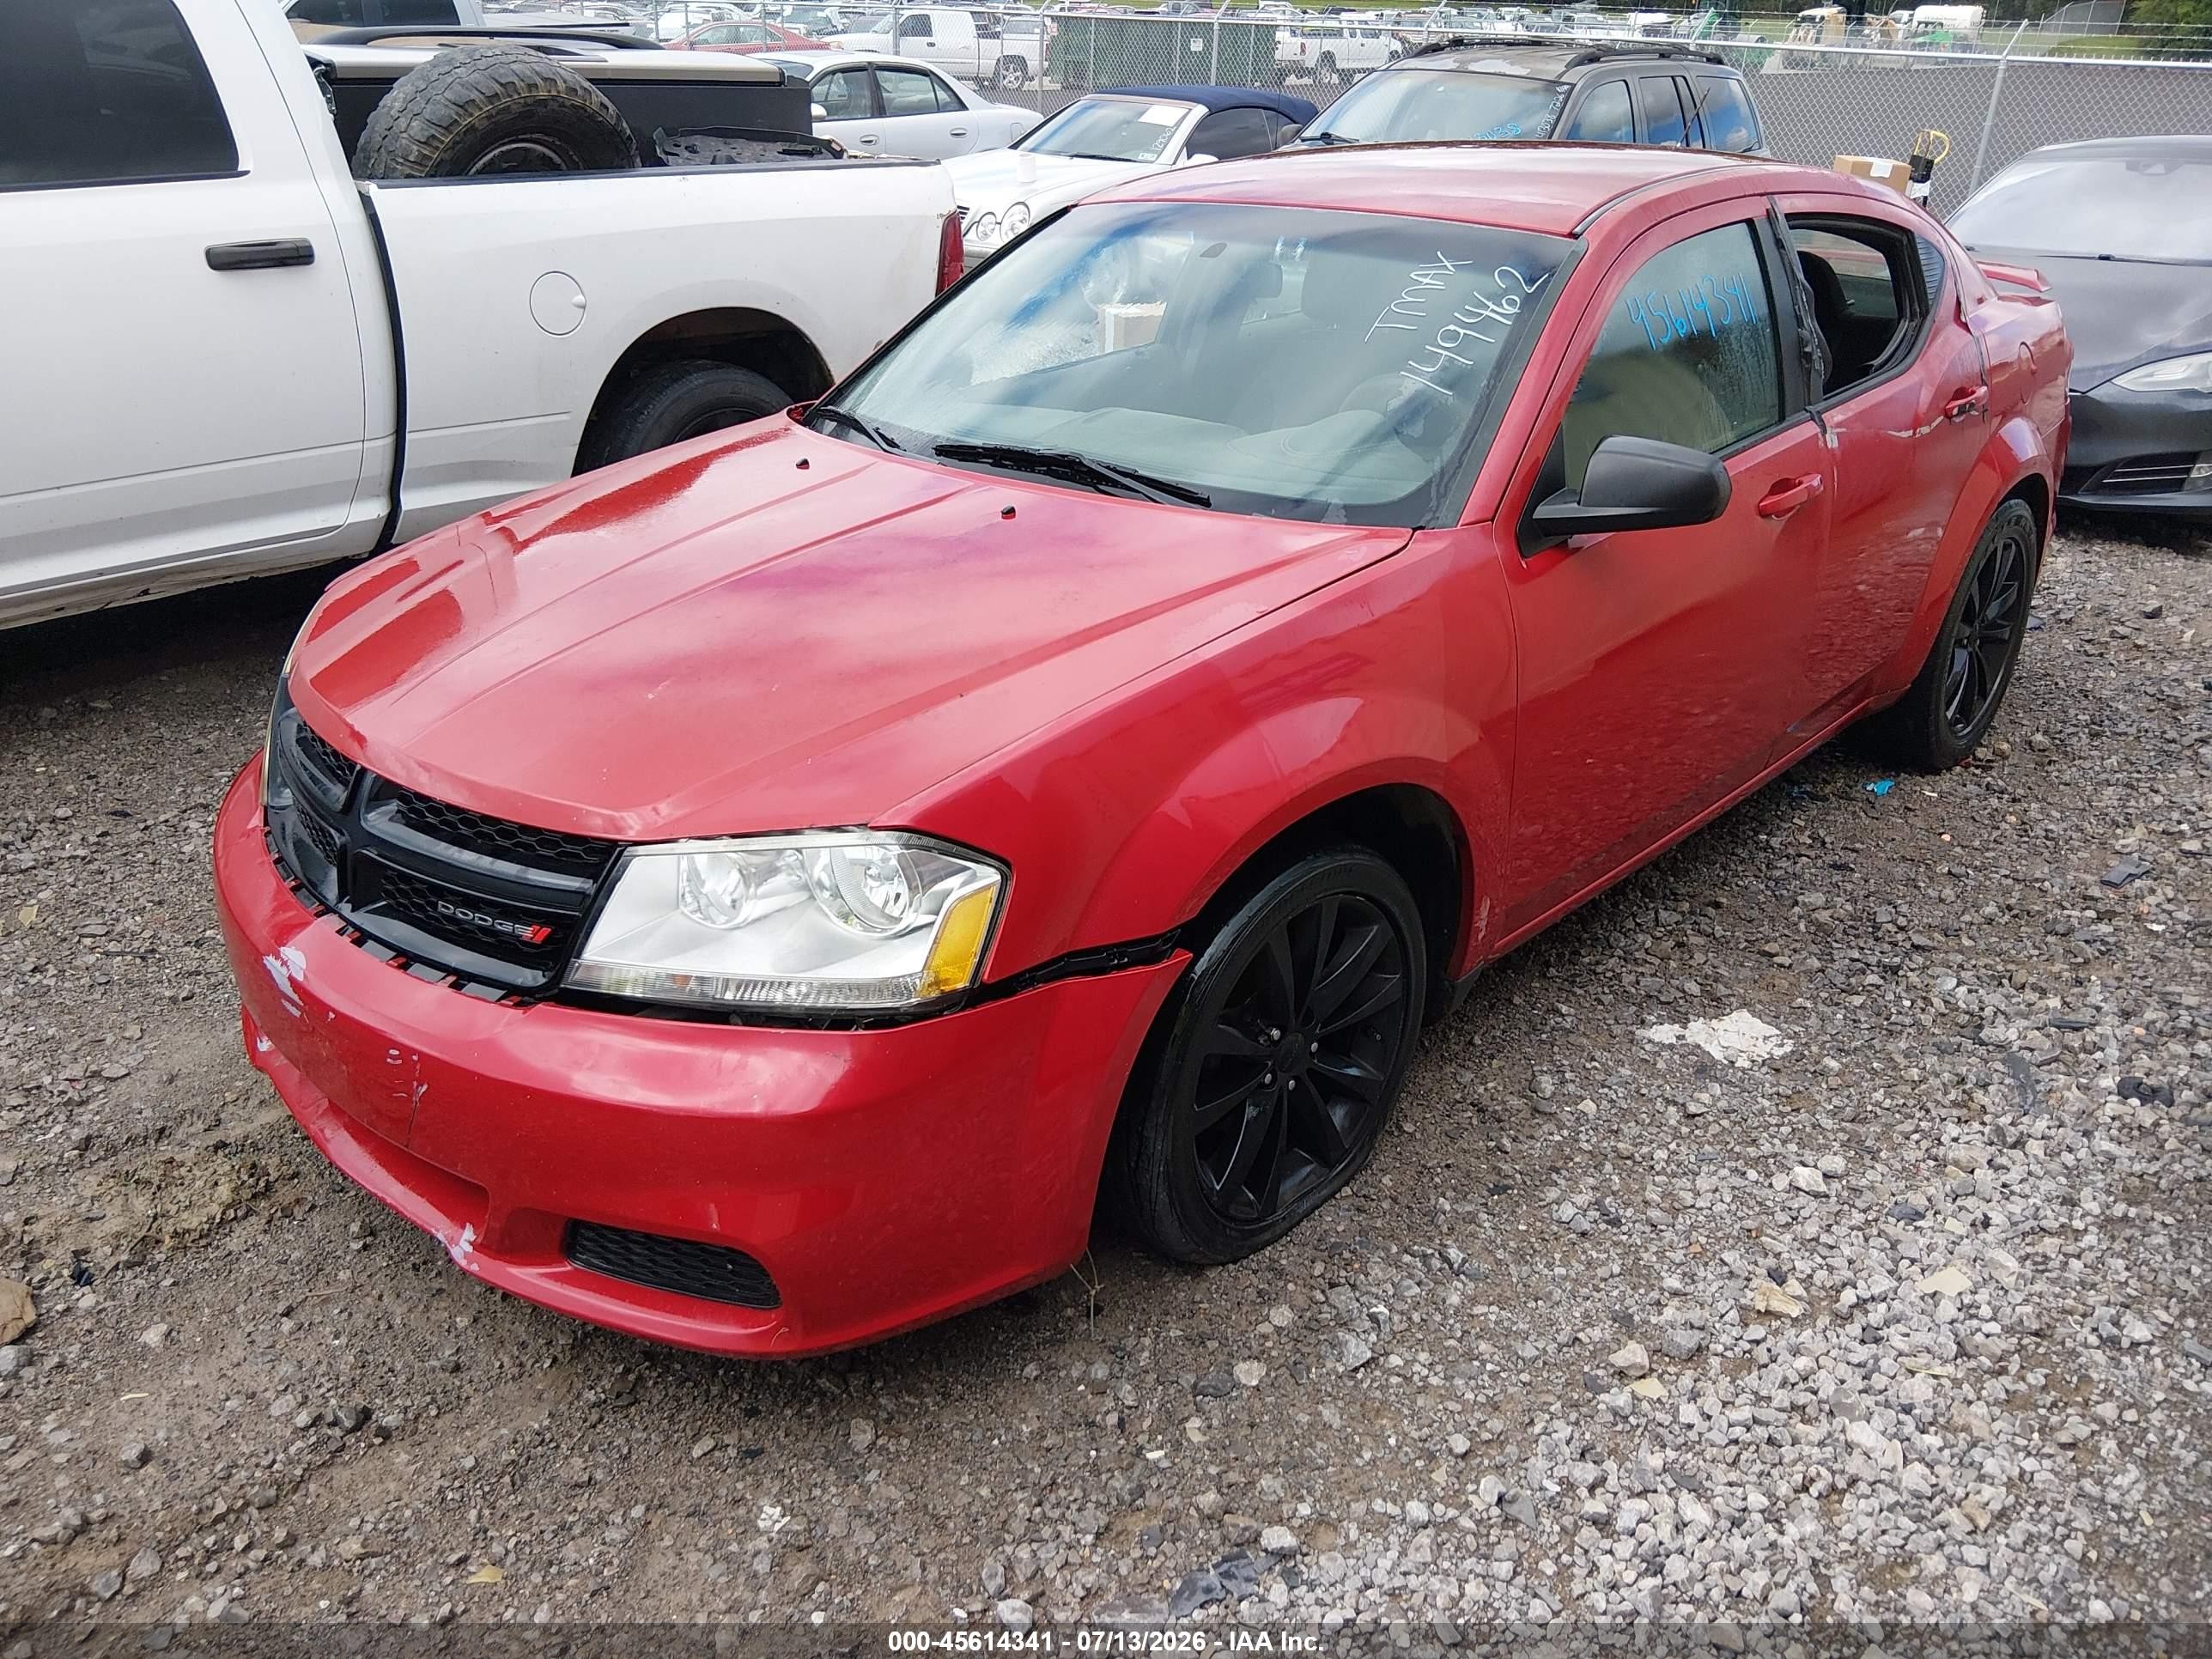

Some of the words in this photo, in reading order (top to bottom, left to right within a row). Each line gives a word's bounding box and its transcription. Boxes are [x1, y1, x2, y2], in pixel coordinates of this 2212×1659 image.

[1364, 250, 1474, 343] TMAX
[1400, 266, 1549, 396] 149462
[1625, 271, 1757, 351] 45614341
[437, 900, 534, 938] DODGE
